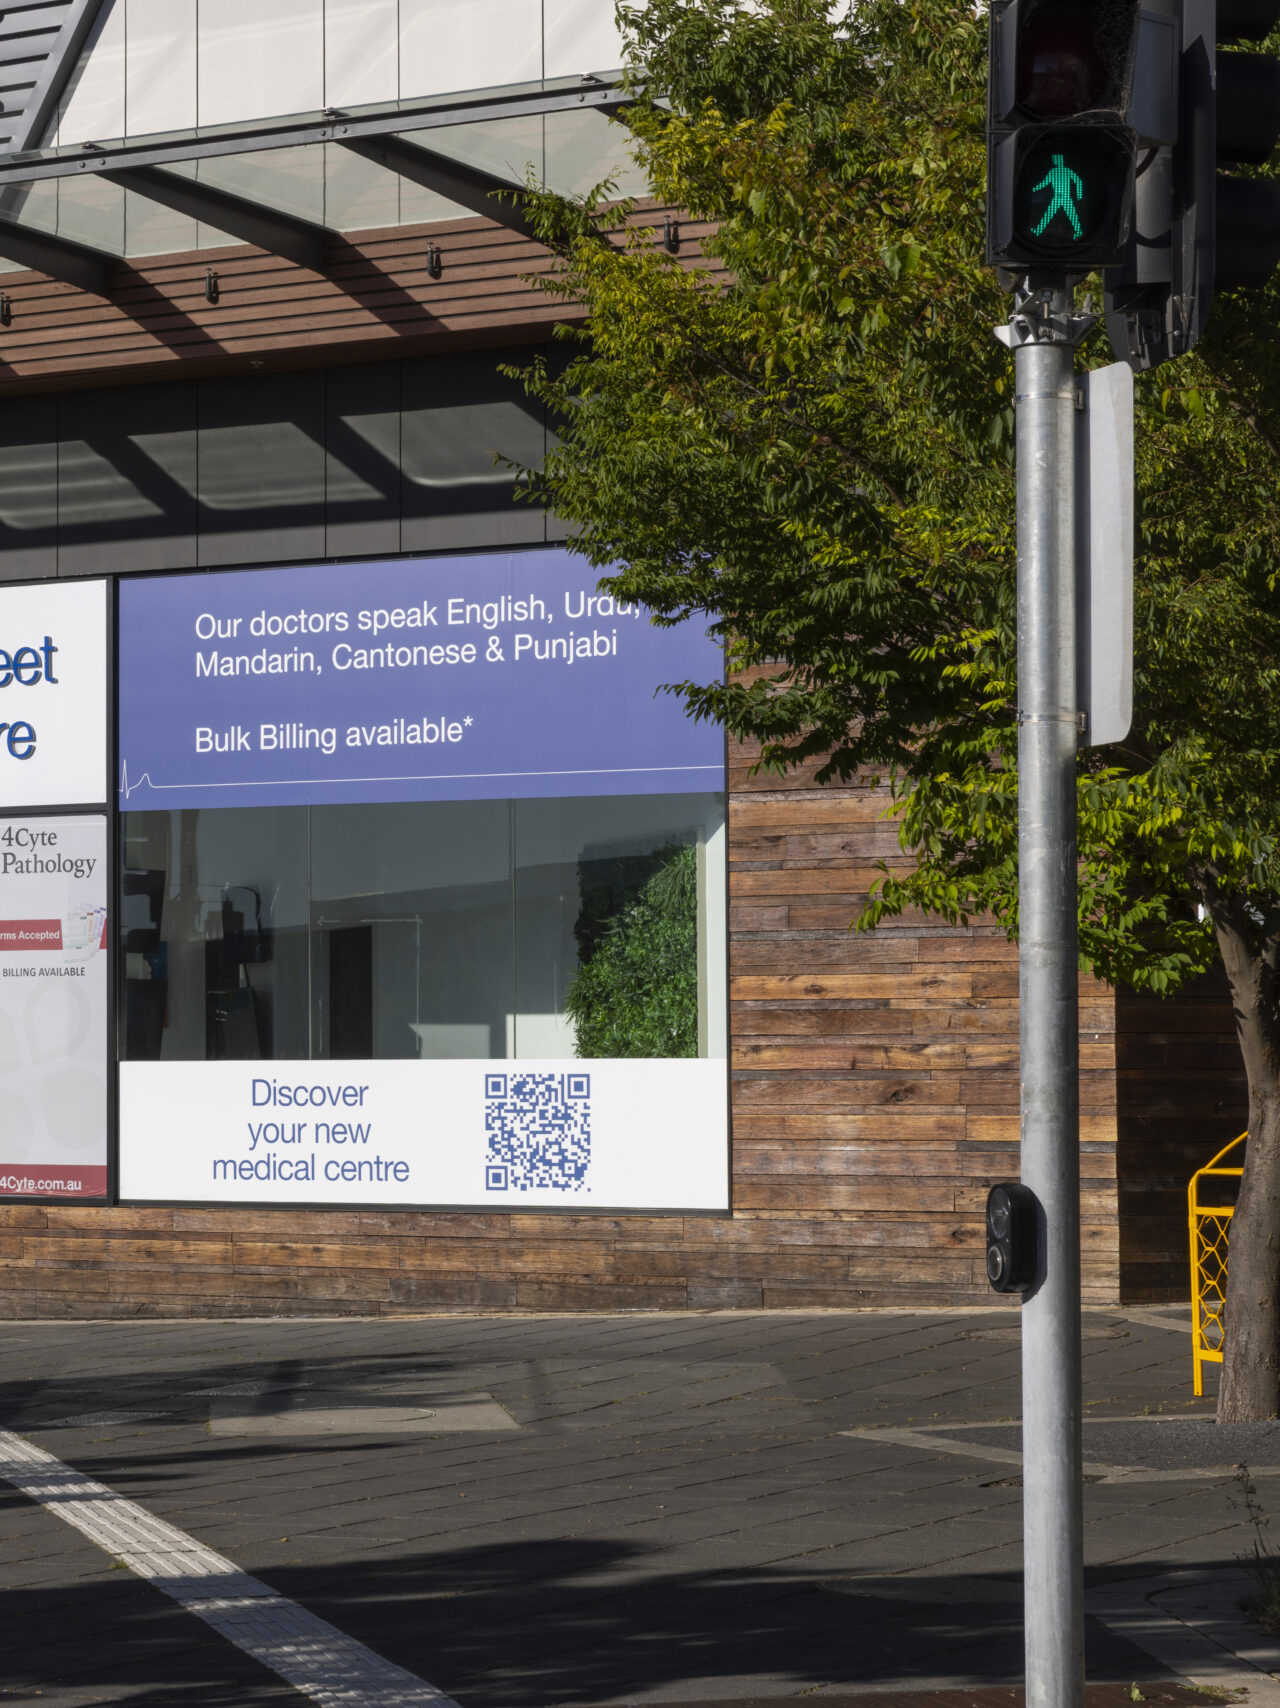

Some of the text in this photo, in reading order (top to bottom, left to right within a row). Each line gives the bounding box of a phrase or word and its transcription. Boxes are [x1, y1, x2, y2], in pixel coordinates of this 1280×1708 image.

[195, 614, 243, 640] Our
[249, 608, 349, 637] doctors
[357, 599, 439, 635] speak
[447, 594, 553, 631] English,
[195, 628, 617, 677] Mandarin, Cantonese & Punjabi
[195, 724, 251, 752] Bulk
[259, 721, 337, 754] Billing
[1, 826, 58, 852] 4Cyte
[2, 851, 97, 879] Pathology
[18, 930, 60, 942] Accepted
[2, 967, 37, 978] BILLING
[38, 966, 86, 977] AVAILABLE
[251, 1079, 369, 1108] Discover
[247, 1118, 372, 1151] your new
[212, 1154, 410, 1182] medical centre
